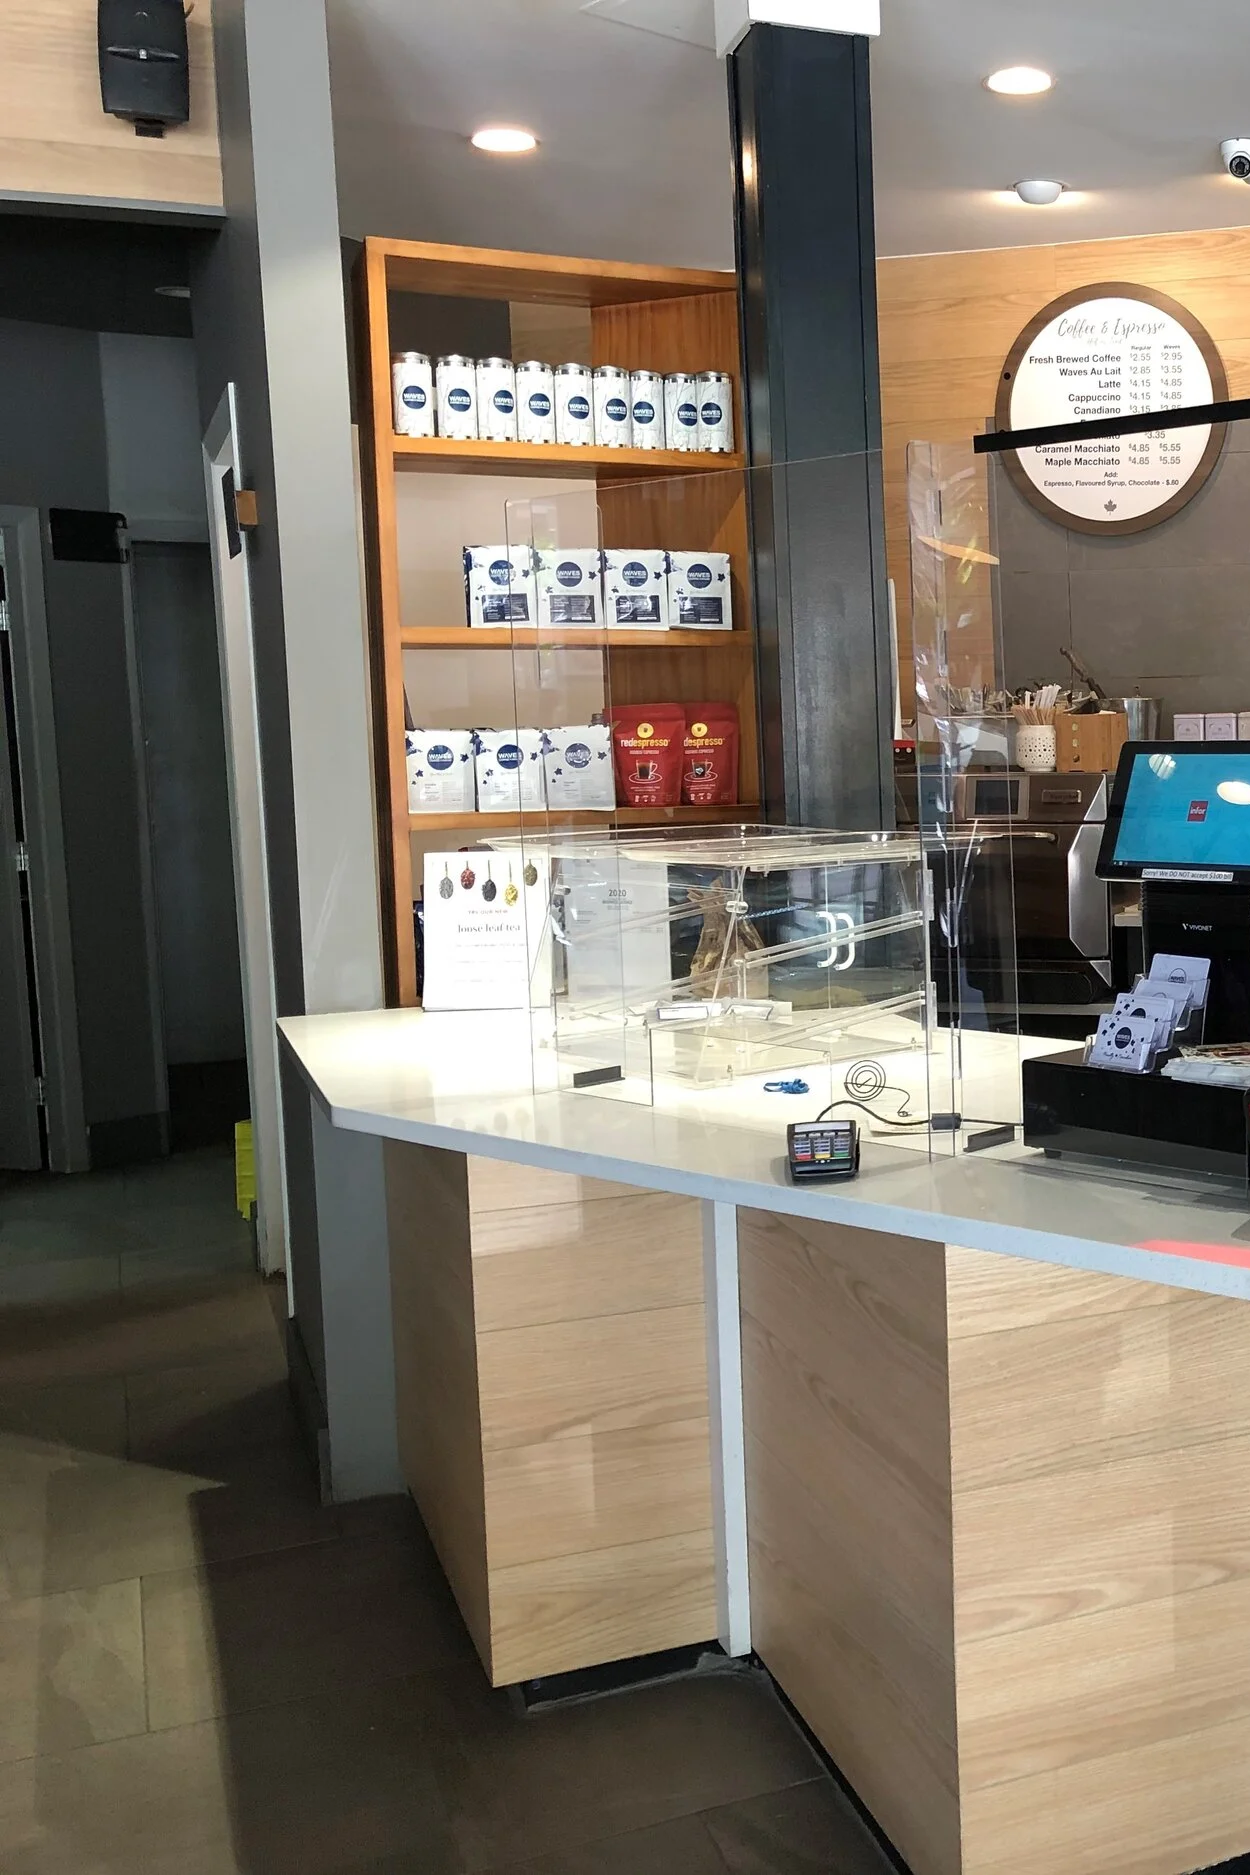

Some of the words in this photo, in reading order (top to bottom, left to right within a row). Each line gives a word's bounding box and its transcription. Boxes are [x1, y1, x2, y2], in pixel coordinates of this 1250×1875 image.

[1058, 318, 1095, 338] Coffee
[1114, 318, 1166, 339] Espresso
[1030, 356, 1053, 364] Fresh
[1057, 355, 1089, 363] Brewed
[1060, 368, 1087, 376] Waves
[1105, 367, 1121, 375] Lait
[1098, 380, 1121, 388] Latte
[1068, 393, 1121, 403] Cappuccino
[1074, 406, 1121, 414] Canadiano
[1045, 458, 1071, 467] Maple
[621, 738, 668, 747] redespresso
[458, 925, 483, 933] loose
[486, 923, 503, 932] leaf
